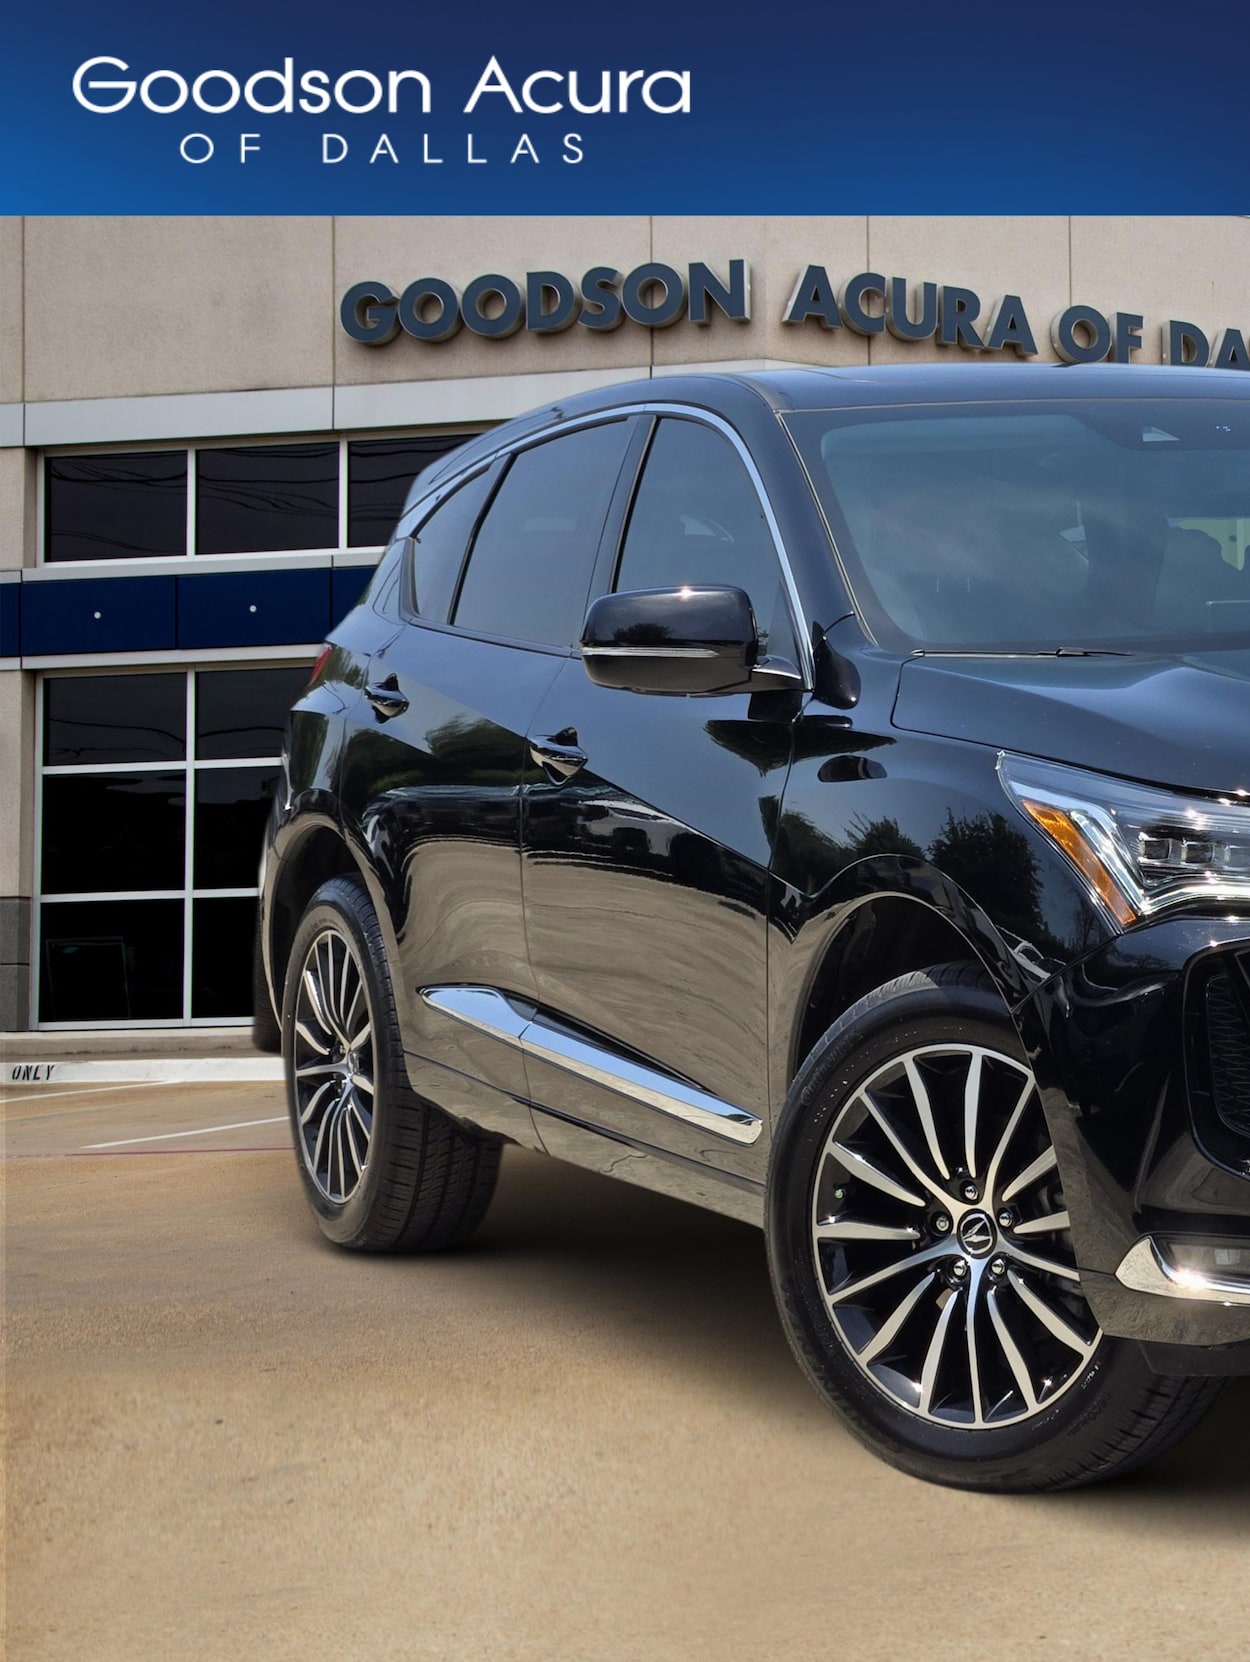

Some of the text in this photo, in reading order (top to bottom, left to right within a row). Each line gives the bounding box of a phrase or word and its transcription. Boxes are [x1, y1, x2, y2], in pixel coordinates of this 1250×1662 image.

[340, 259, 751, 345] GOODSON
[782, 264, 1038, 357] ACURA
[1052, 304, 1144, 364] OF
[12, 1064, 55, 1081] ONLY
